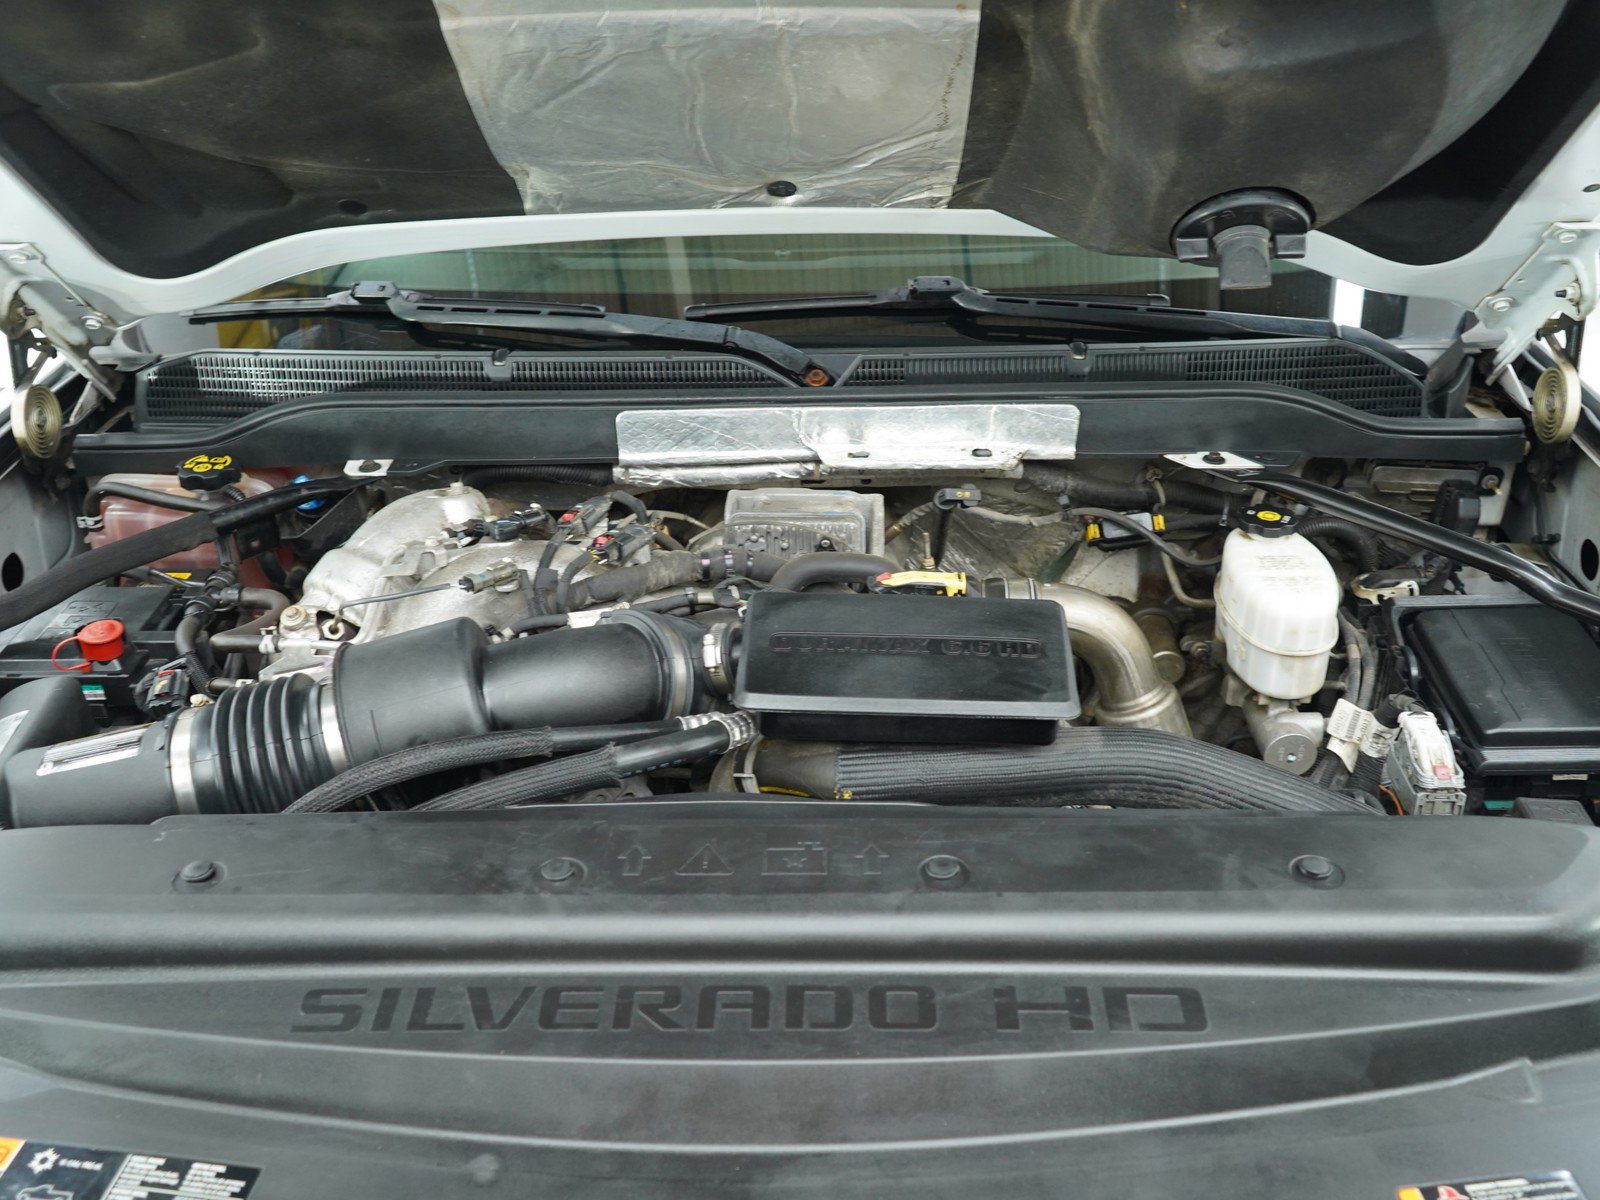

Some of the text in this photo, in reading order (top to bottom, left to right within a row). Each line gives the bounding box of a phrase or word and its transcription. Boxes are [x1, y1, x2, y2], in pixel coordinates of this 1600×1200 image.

[773, 636, 1042, 659] DURAMAX 6.6 HD
[290, 984, 1209, 1033] SILVERADO HD
